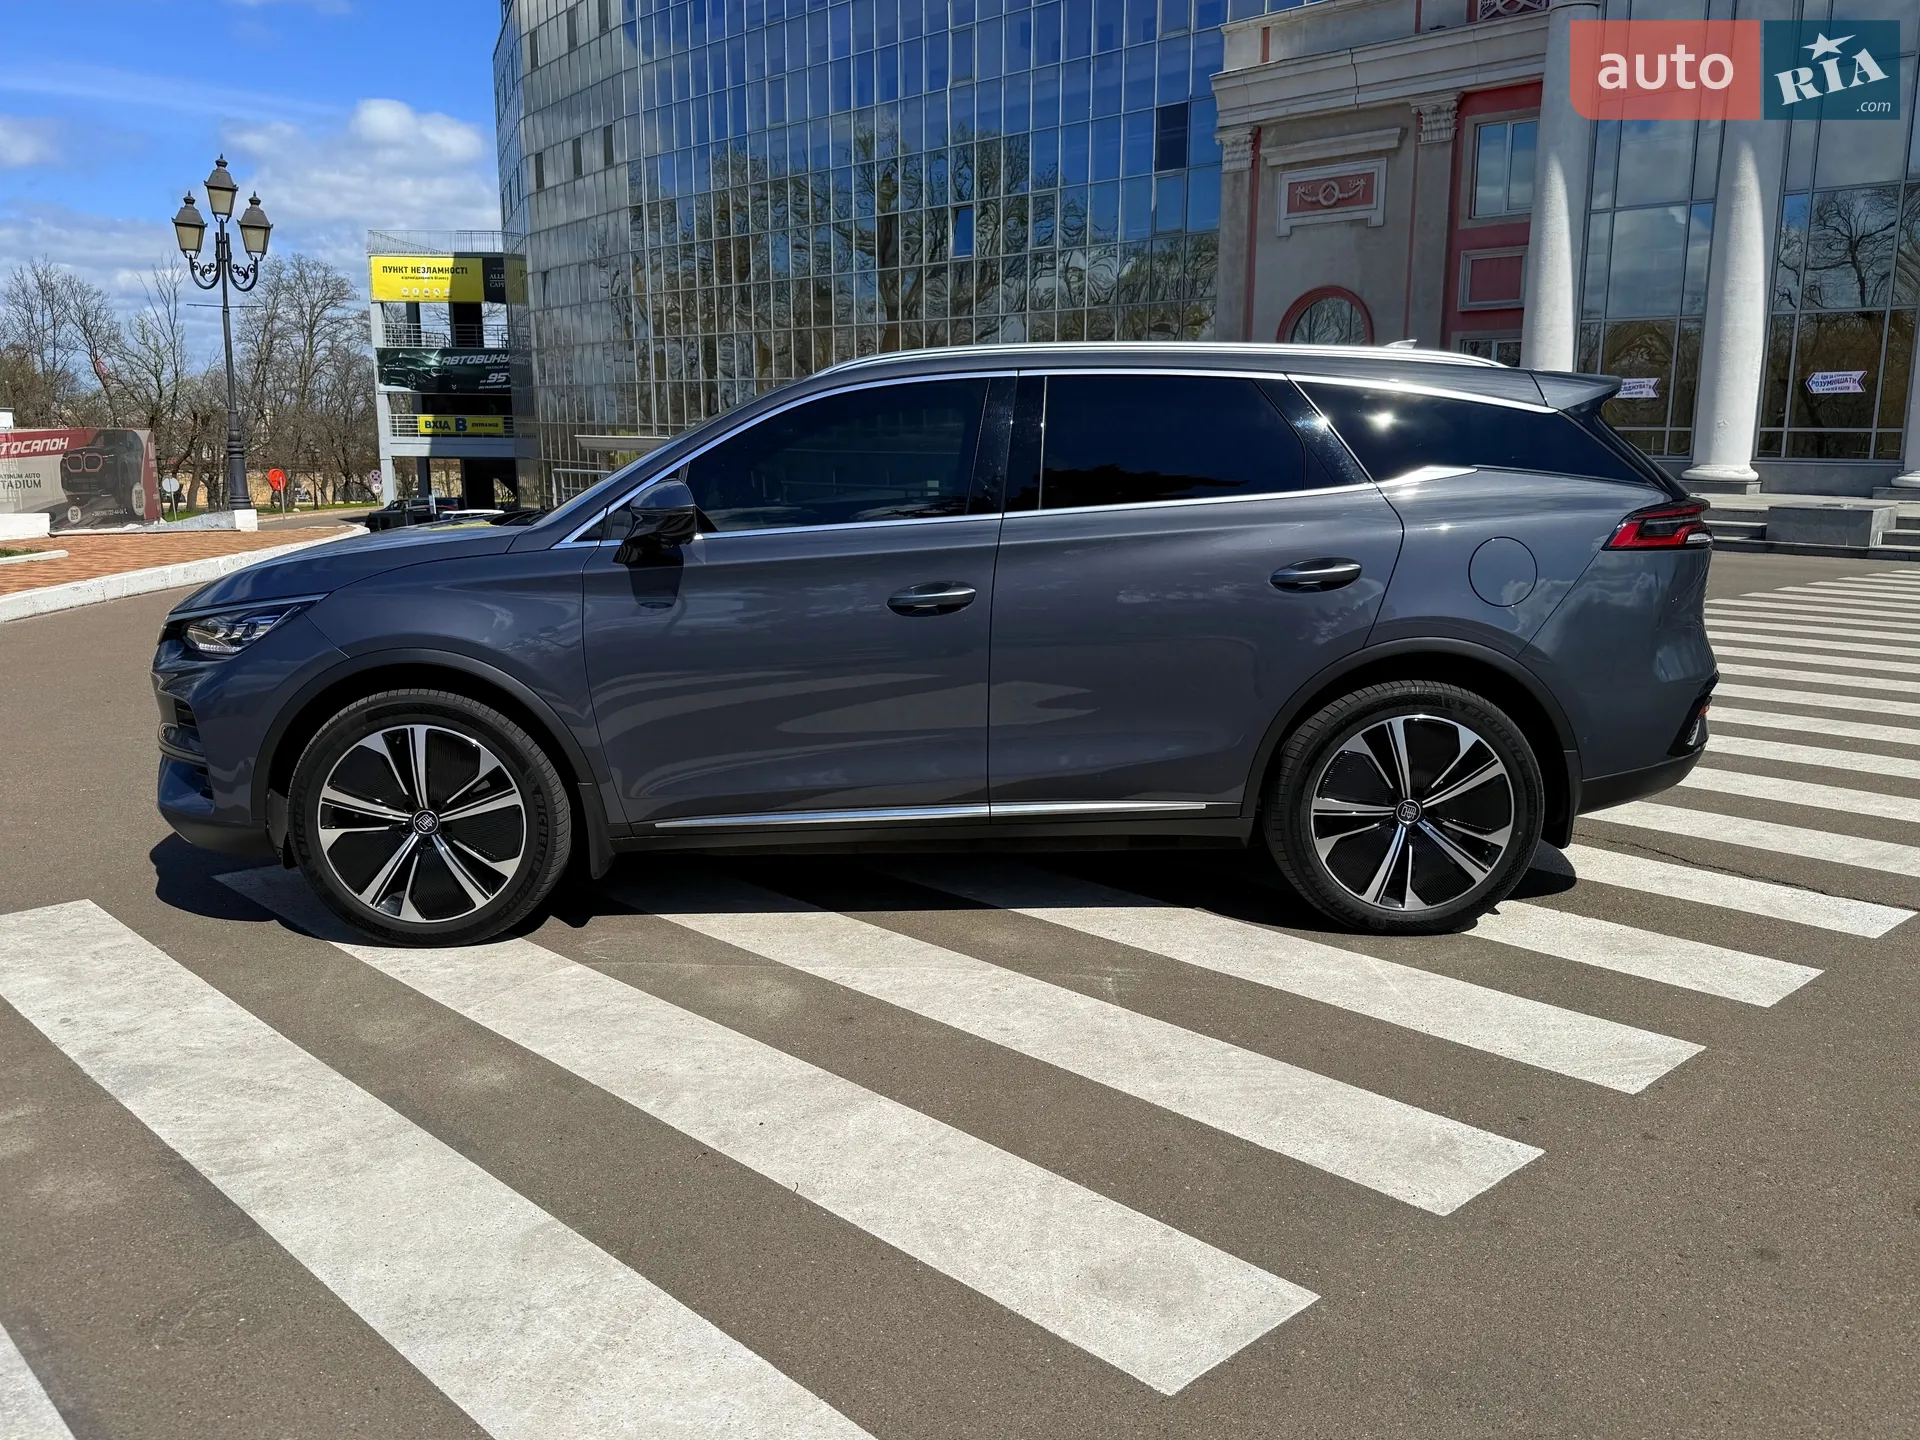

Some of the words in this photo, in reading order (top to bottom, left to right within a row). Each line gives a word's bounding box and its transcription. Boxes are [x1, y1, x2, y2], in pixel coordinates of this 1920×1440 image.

[382, 265, 408, 274] ПУНКТ
[411, 266, 468, 275] НЕЗЛАМНОСТІ
[424, 420, 451, 431] ВХІД
[1463, 704, 1526, 762] MICHELIN
[531, 793, 548, 872] MICHELIN
